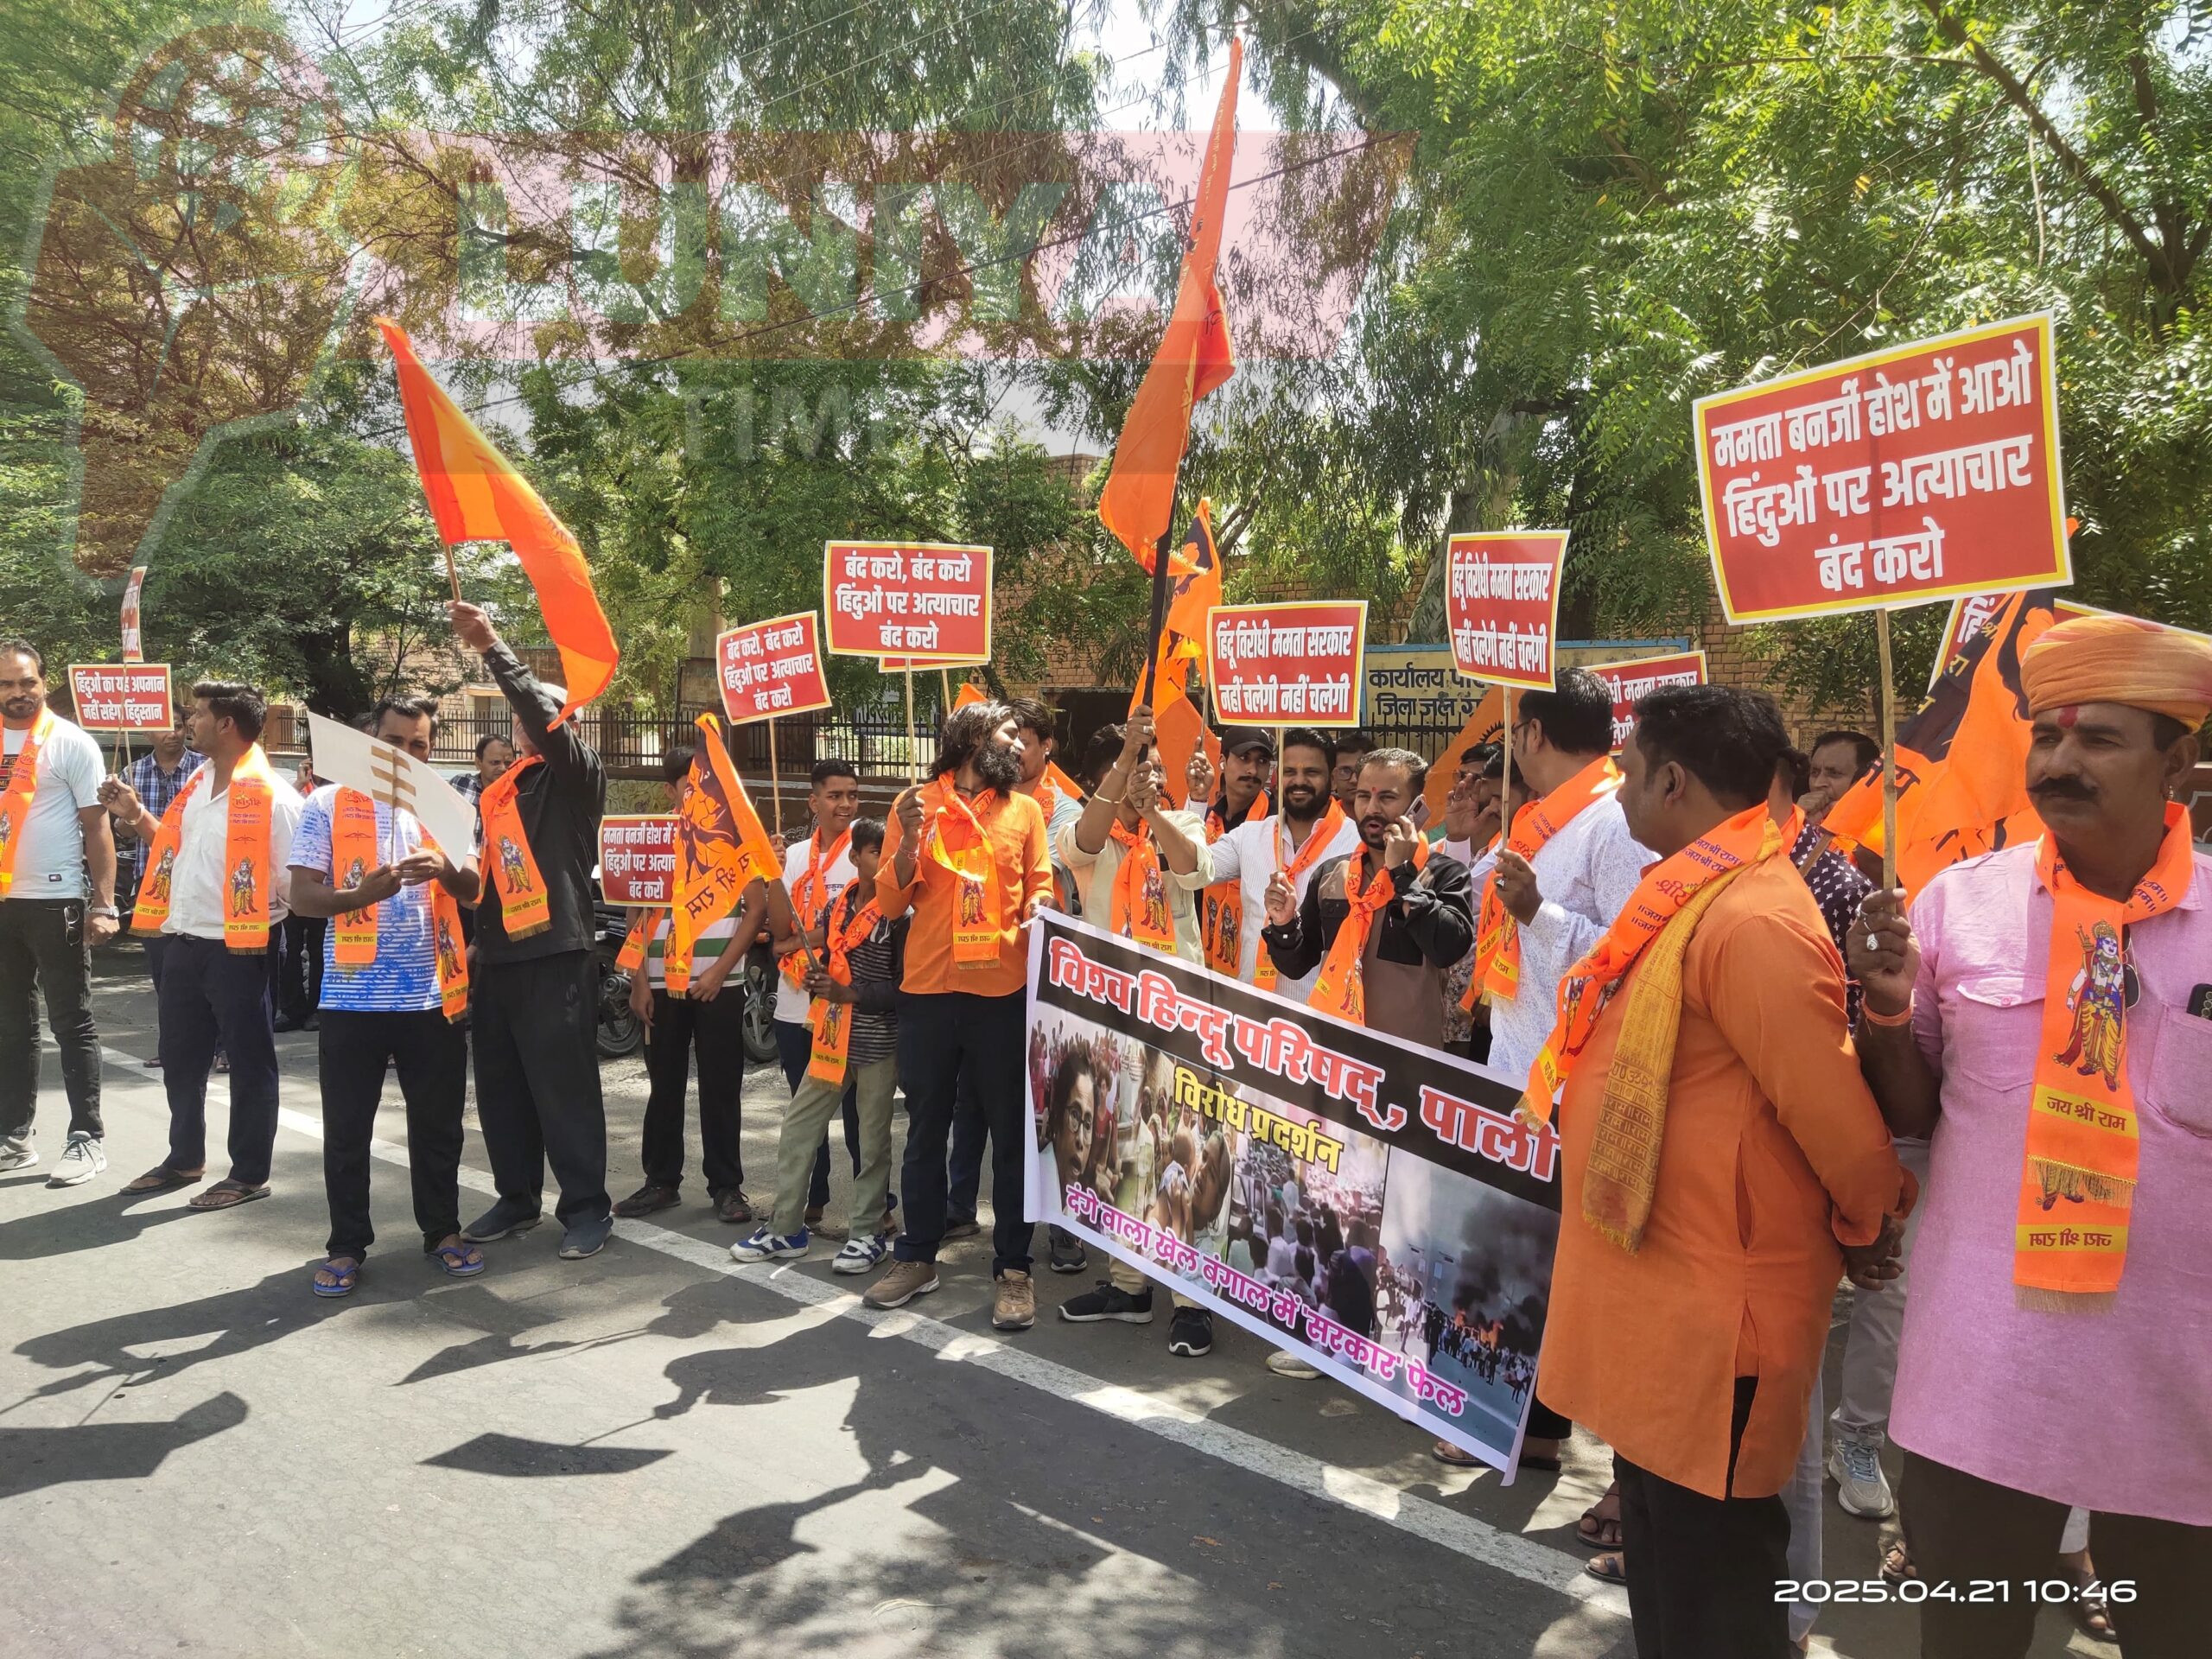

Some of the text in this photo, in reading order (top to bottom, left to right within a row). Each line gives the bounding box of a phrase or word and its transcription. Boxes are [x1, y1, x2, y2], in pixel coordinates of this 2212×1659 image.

[1711, 339, 2032, 467] ममता बनर्जी होश में आओ
[1723, 434, 2032, 547] हिंदुओं पर अत्याचार
[844, 550, 972, 584] बंद करो, बंद करो
[1815, 517, 1945, 592] बंद करो
[1452, 551, 1553, 611] हिंदू विरोधी ममता सरकार
[836, 583, 982, 620] हिंदुओं पर अत्याचार
[727, 620, 804, 660] बंद करो, बंद करो
[879, 620, 939, 649] बंद करो
[1216, 619, 1354, 670] हिंदू विरोधी ममता सरकार
[1453, 618, 1548, 674] नहीं चलेगी नहीं चलेगी
[74, 671, 101, 698] हिंदुओं
[101, 677, 114, 693] का
[130, 676, 166, 692] अपमान
[724, 653, 814, 690] हिंदुओं पर अत्याचार
[1369, 661, 1446, 689] कार्यालय
[753, 683, 792, 710] बंद करो
[1218, 673, 1351, 714] नहीं चलेगी नहीं चलेगी
[1376, 692, 1417, 715] जिला
[81, 699, 99, 721] नहीं
[124, 698, 162, 727] हिंदुस्तान
[603, 826, 624, 845] ममता
[625, 822, 646, 845] बनर्जी
[645, 823, 661, 845] होश
[663, 821, 673, 845] में
[604, 848, 677, 877] हिंदुओं पर अत्या
[629, 876, 664, 899] बंद करो
[1049, 936, 1136, 1014] विश्व
[1137, 969, 1234, 1070] हिन्दू
[1419, 1084, 1560, 1182] पाली
[1174, 1065, 1344, 1174] विरोध प्रदर्शन
[2047, 1096, 2126, 1132] जय श्री राम
[1066, 1182, 1099, 1224] दंगे
[1100, 1202, 1152, 1249] वाला
[1154, 1227, 1199, 1272] खेल
[1202, 1253, 1273, 1313] बंगाल
[1273, 1287, 1302, 1329] में
[1407, 1355, 1467, 1417] फेल
